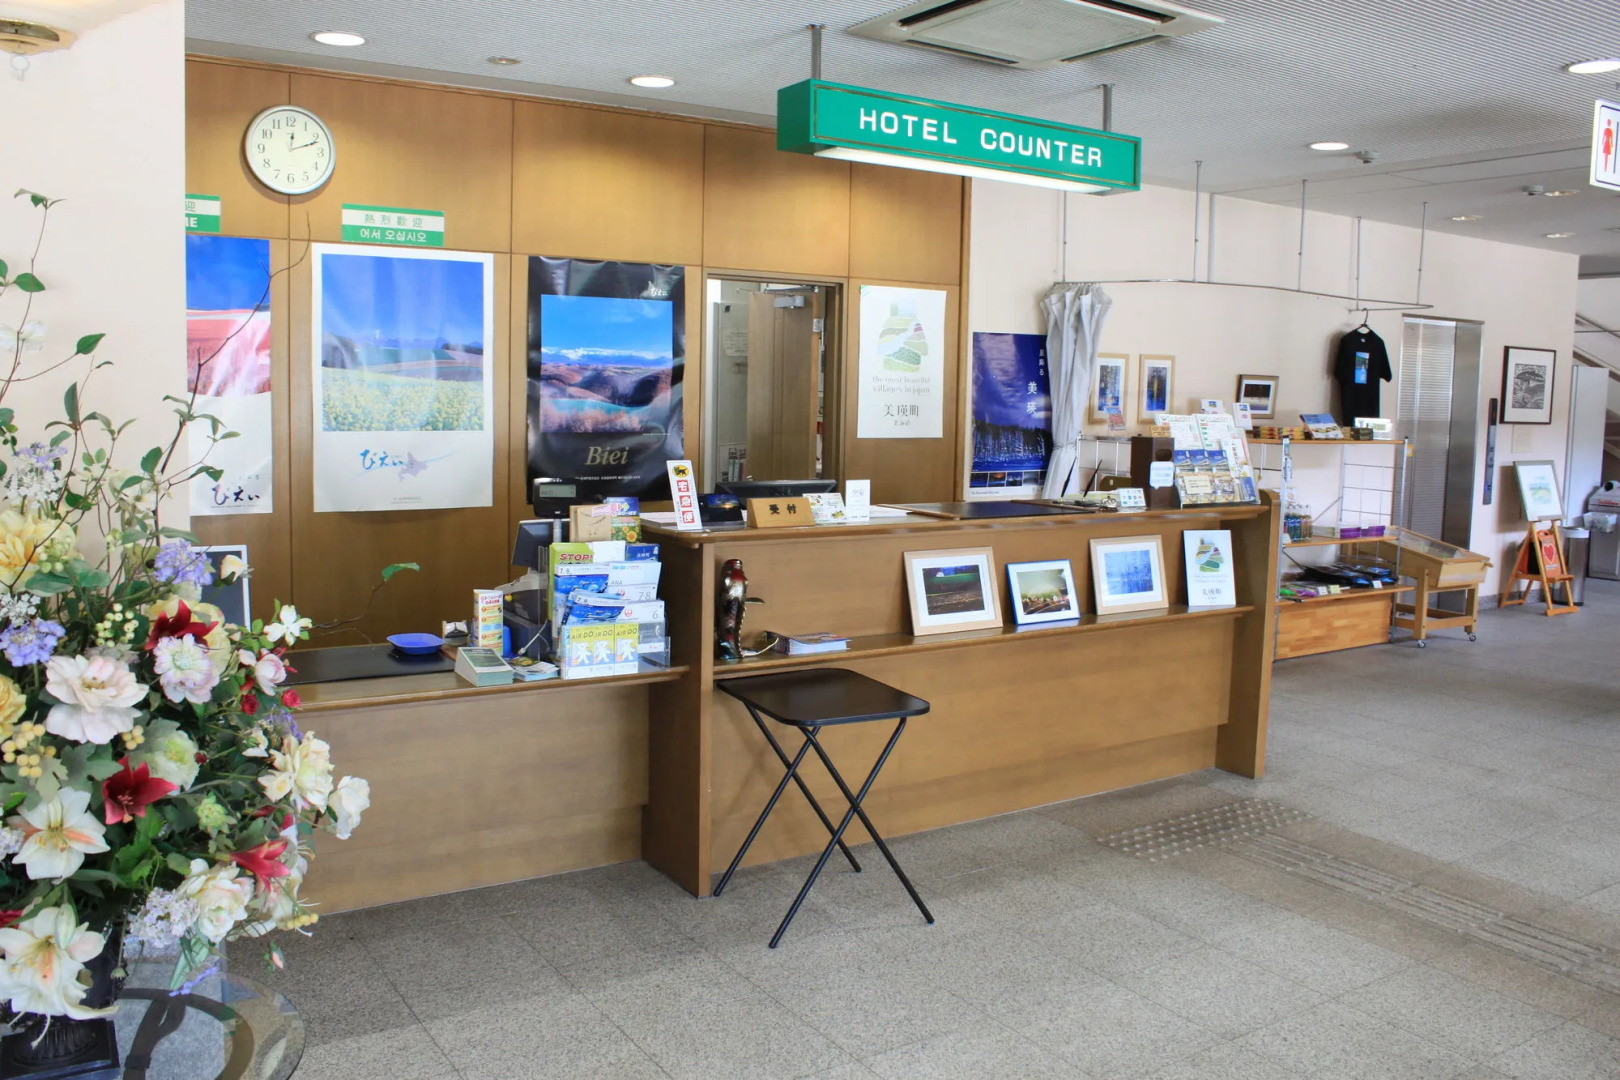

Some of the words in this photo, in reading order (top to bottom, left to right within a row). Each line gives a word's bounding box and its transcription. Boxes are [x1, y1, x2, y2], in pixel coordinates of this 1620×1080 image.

[272, 119, 281, 130] 11
[285, 116, 297, 128] 12
[303, 121, 308, 132] 1
[261, 128, 273, 140] 10
[312, 132, 320, 142] 2
[859, 107, 958, 145] HOTEL
[980, 127, 1103, 169] COUNTER
[257, 143, 266, 154] 9
[317, 147, 325, 158] 3
[263, 158, 271, 168] 8
[312, 161, 319, 172] 4
[273, 169, 281, 180] 7
[287, 172, 296, 184] 6
[302, 171, 310, 182] 5
[360, 228, 381, 240] 어서
[385, 230, 427, 243] 오십시오
[1026, 381, 1038, 416] 美瑛
[883, 403, 919, 417] 美瑛町
[360, 448, 404, 471] びえい
[584, 446, 630, 466] Biei
[769, 503, 797, 515] 受付
[627, 627, 638, 635] DO
